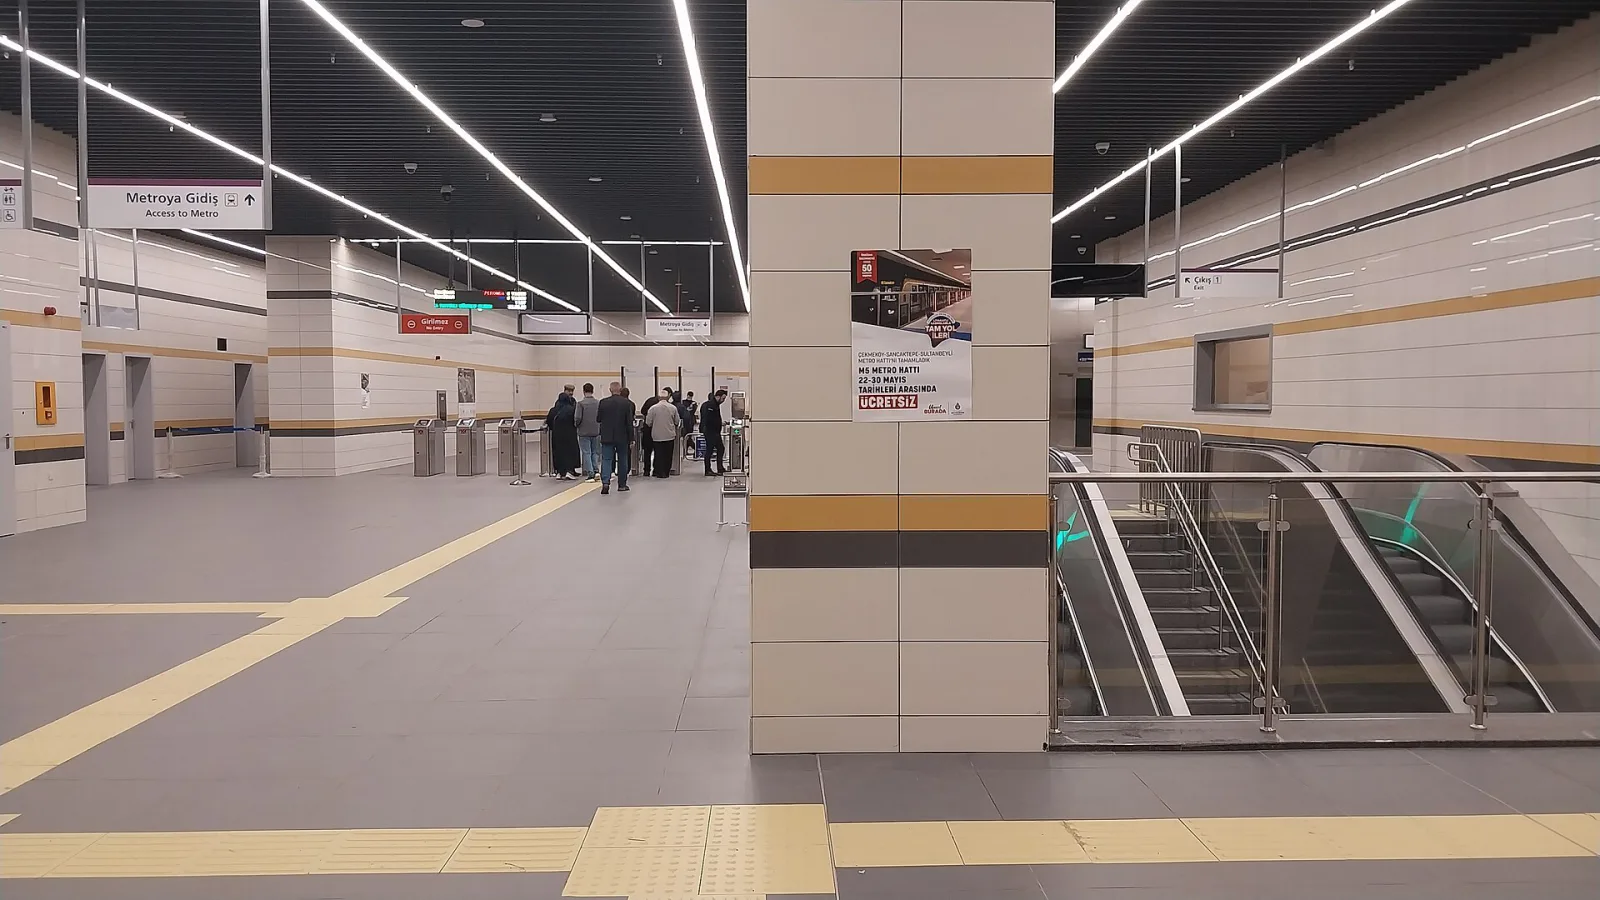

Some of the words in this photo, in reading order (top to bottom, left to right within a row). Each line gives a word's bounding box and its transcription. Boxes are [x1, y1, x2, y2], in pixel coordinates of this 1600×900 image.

[126, 192, 182, 206] Metroya
[185, 192, 219, 206] Gidiş
[145, 209, 176, 217] Access
[178, 209, 188, 217] to
[190, 209, 219, 217] Metro
[872, 366, 897, 374] METRO
[859, 384, 896, 393] TARİHLERİ
[898, 385, 937, 393] ARASINDA
[860, 396, 917, 408] ÜCRETSİZ
